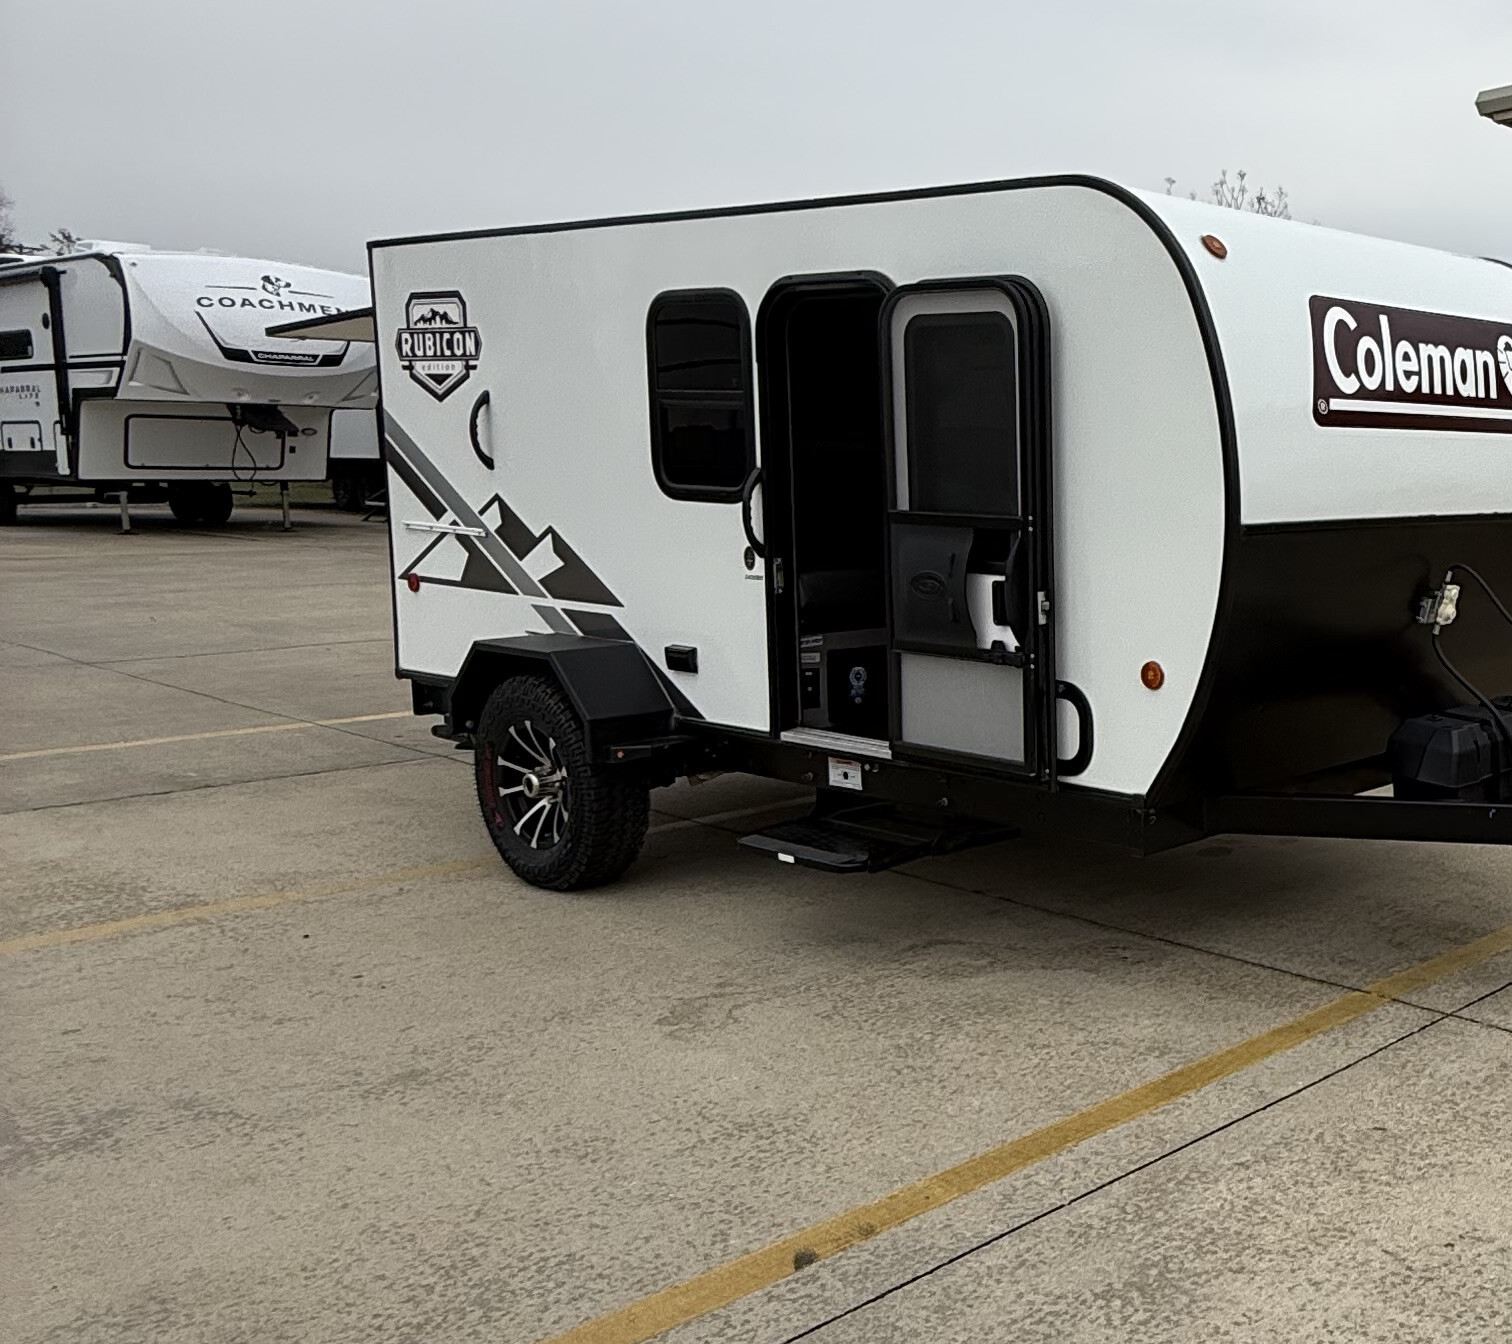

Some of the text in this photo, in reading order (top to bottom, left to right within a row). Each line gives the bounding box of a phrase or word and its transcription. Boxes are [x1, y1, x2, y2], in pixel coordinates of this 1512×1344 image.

[401, 331, 477, 357] RUBICON
[1323, 306, 1498, 399] Coleman
[421, 363, 456, 372] edition
